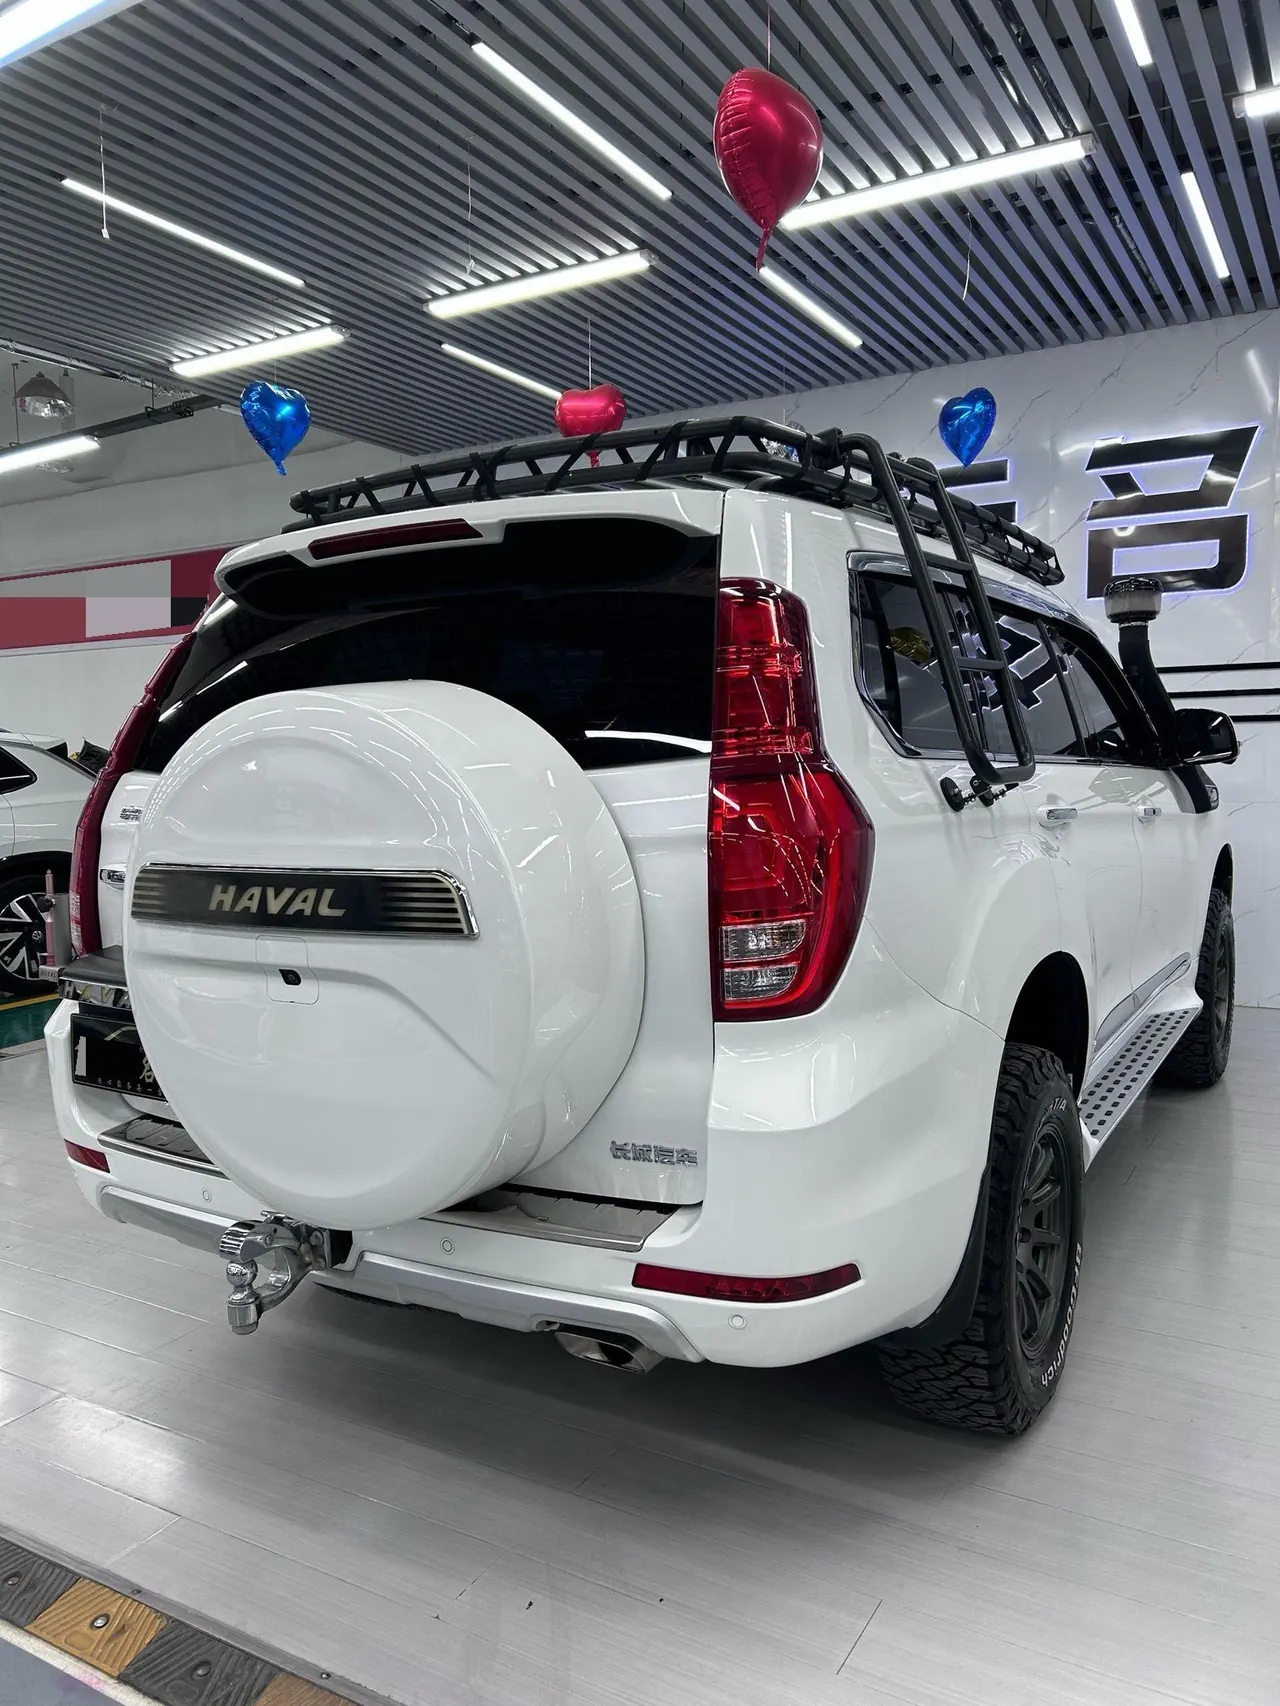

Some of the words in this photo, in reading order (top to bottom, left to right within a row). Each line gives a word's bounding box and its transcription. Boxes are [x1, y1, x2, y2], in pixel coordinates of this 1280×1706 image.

[208, 884, 346, 917] HAVAL
[610, 1140, 698, 1167] 长城汽车
